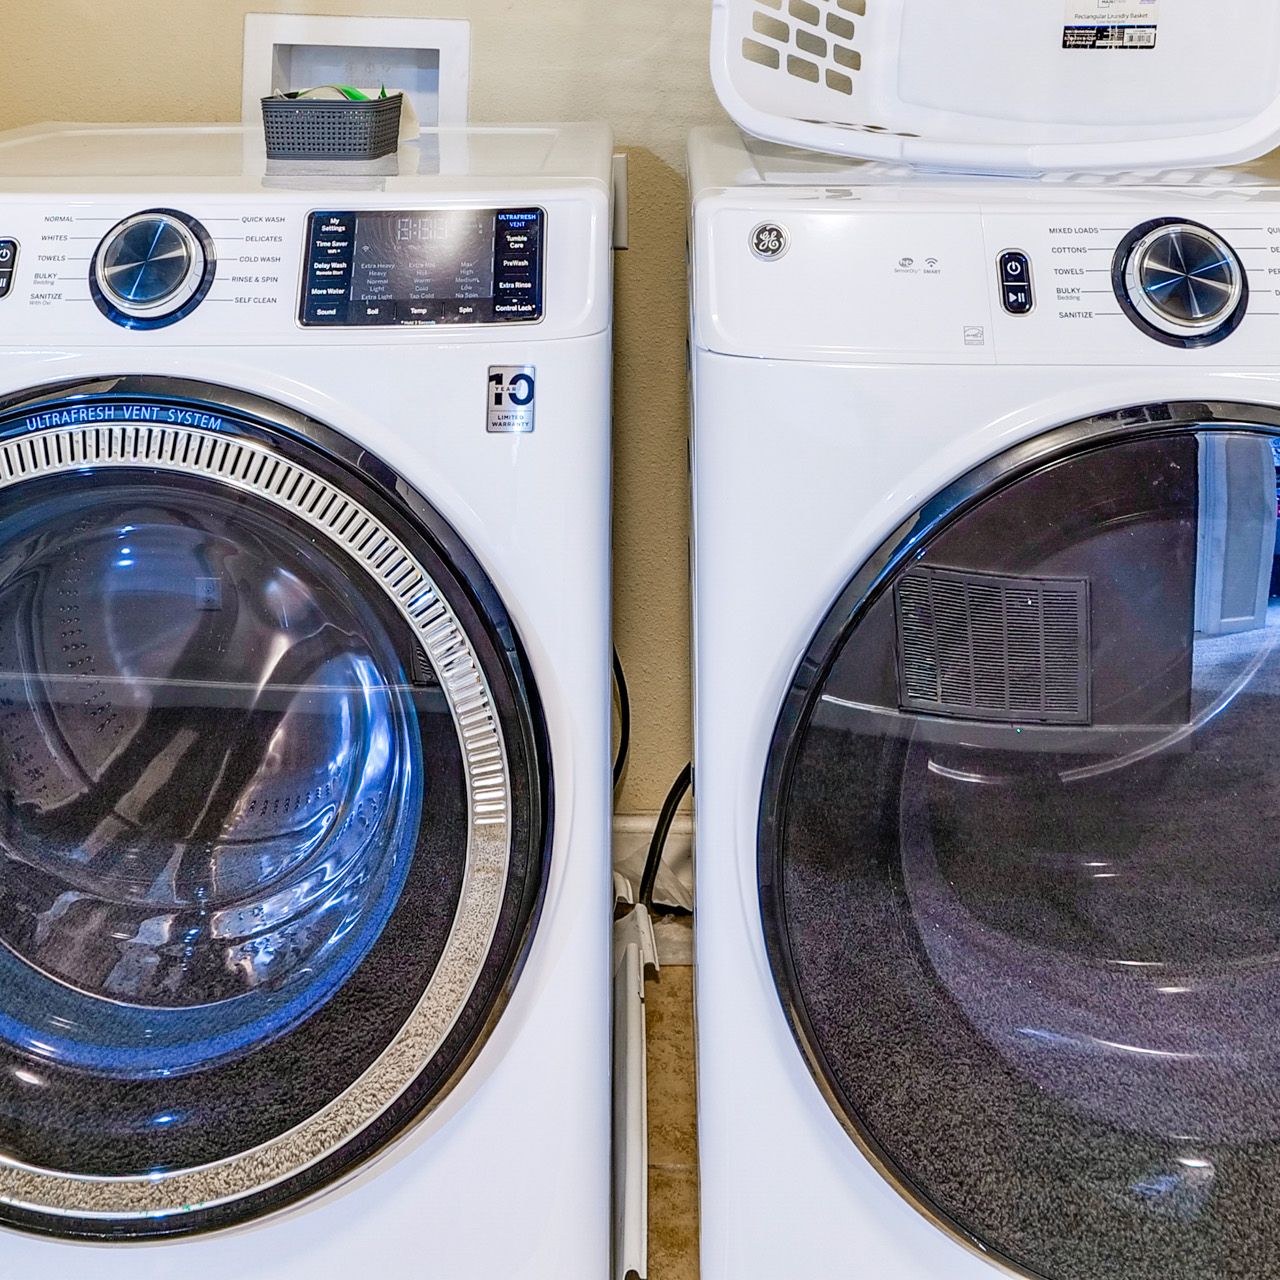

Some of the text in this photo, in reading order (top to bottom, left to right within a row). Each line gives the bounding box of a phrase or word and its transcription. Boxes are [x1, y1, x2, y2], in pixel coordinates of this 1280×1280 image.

[314, 262, 330, 270] Delay
[316, 308, 336, 316] Sound
[410, 307, 427, 315] Temp
[459, 306, 473, 314] Spin
[489, 373, 534, 405] 10
[26, 406, 222, 432] ULTRAFRESH VENT SYSTEM
